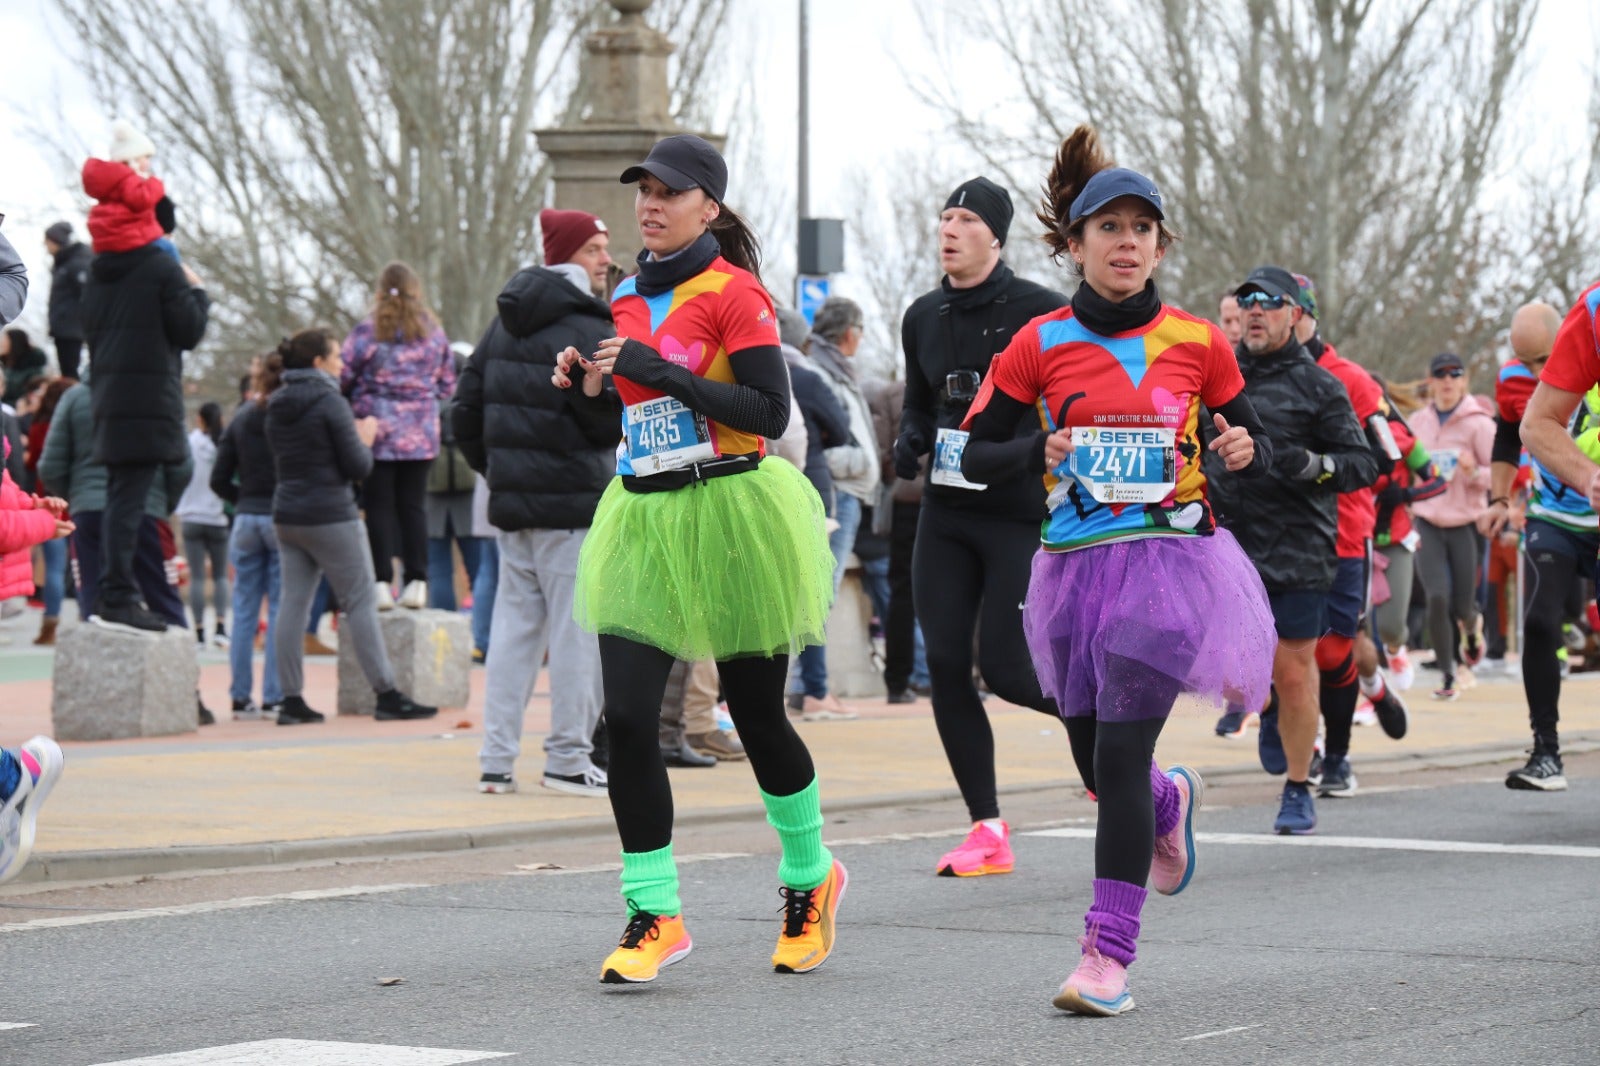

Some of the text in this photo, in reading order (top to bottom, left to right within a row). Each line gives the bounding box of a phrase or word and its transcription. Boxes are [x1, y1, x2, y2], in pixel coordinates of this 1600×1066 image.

[643, 400, 682, 417] SETE
[1093, 414, 1107, 423] SAN
[1107, 414, 1141, 423] SILVESTRE
[639, 414, 680, 449] 4135
[1100, 431, 1164, 444] SETEL
[1089, 447, 1146, 477] 2471
